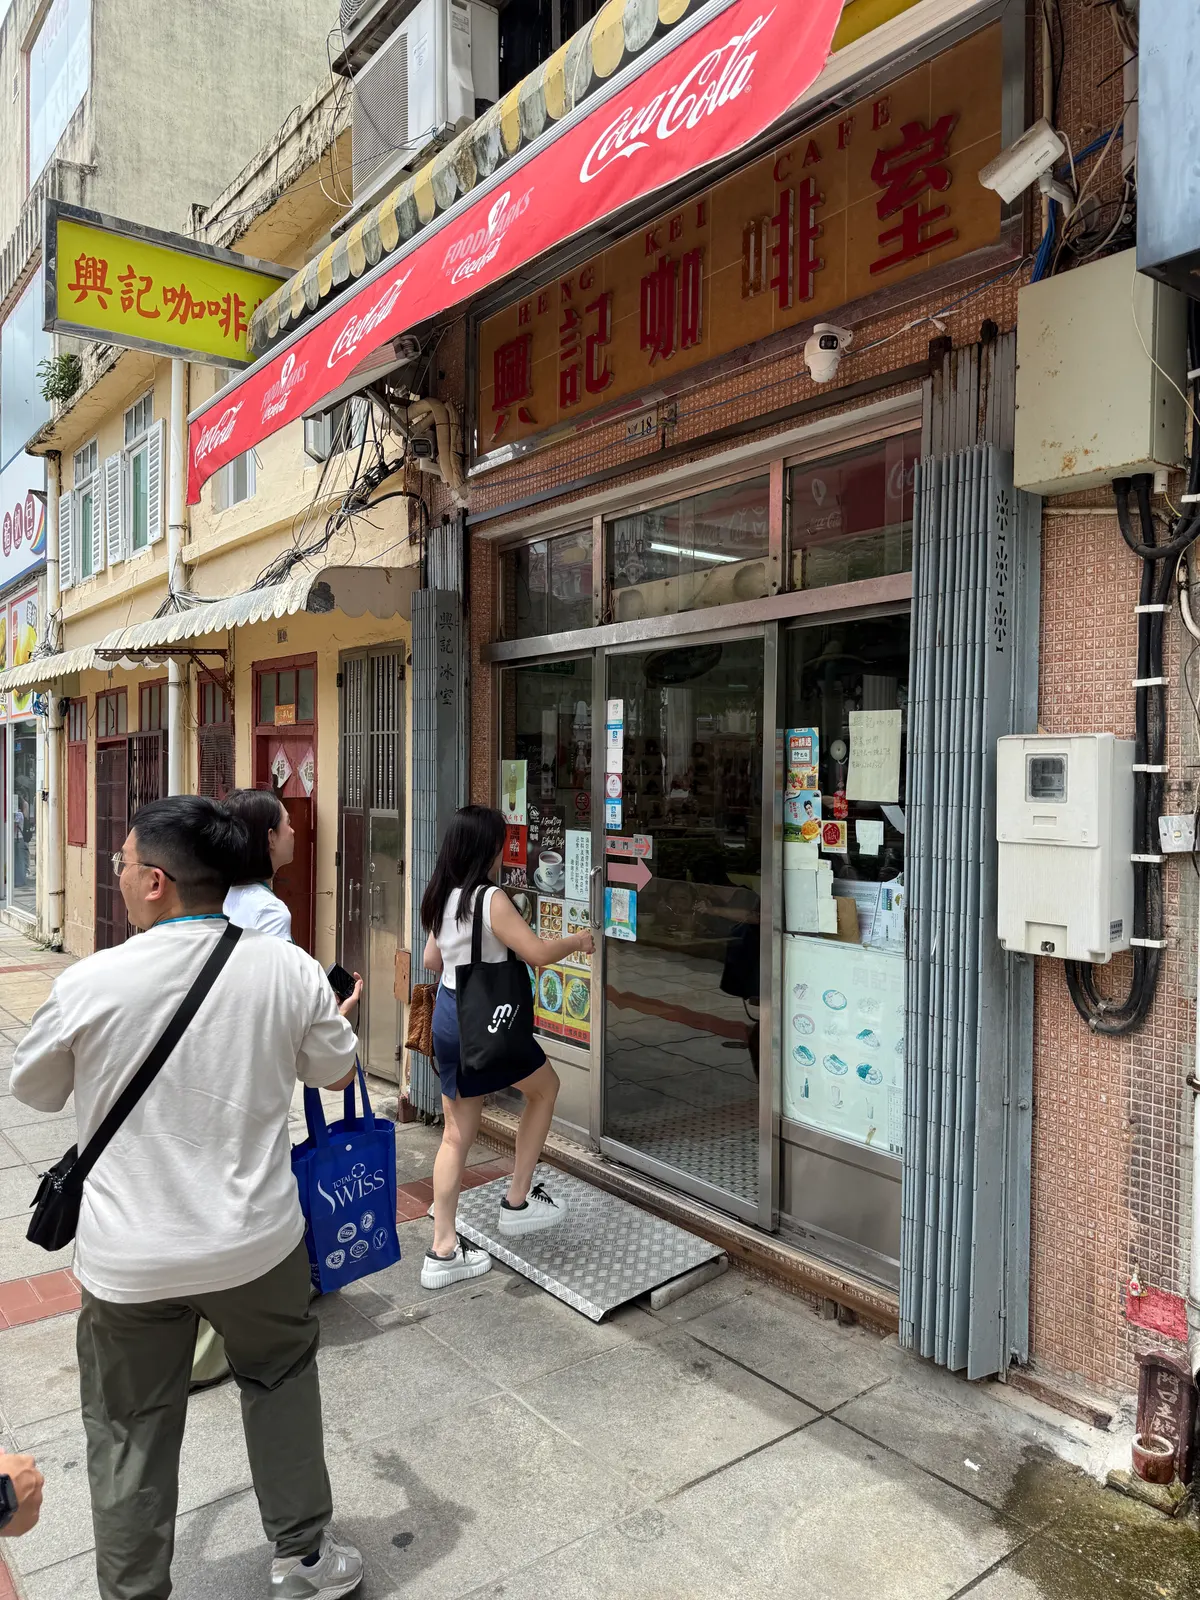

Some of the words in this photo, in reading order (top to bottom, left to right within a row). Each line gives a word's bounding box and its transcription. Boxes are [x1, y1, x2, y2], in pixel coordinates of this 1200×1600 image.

[579, 5, 777, 183] Coca-Cola
[451, 229, 508, 284] Coca-Cola
[518, 266, 594, 327] HENG
[645, 203, 706, 256] KEI
[773, 96, 892, 182] CAFE
[67, 252, 264, 342] 興記咖啡
[327, 264, 416, 368] Coca-Cola
[317, 1169, 385, 1215] SWISS
[332, 1174, 353, 1189] TOTAL
